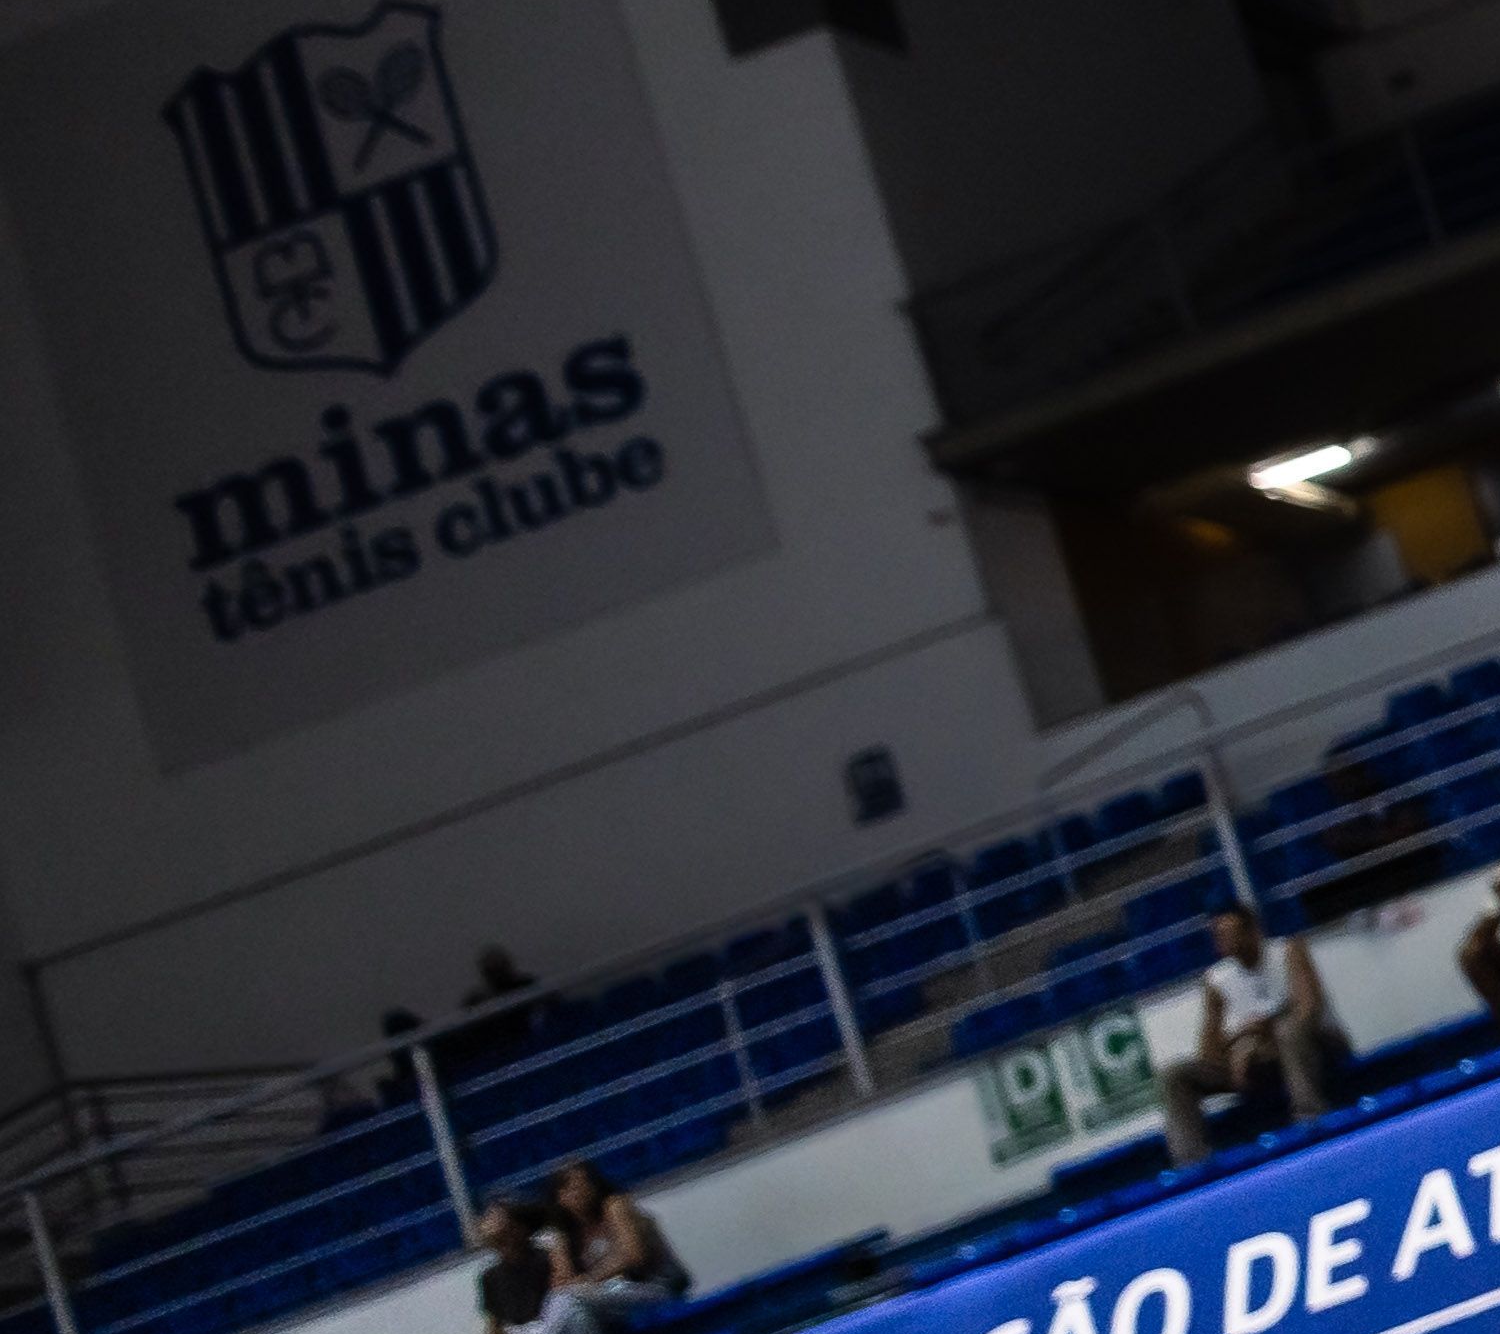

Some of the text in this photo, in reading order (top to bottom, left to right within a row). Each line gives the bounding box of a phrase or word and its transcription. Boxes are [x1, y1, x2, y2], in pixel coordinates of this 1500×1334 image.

[176, 334, 645, 571] minas
[203, 436, 665, 641] tênis clube
